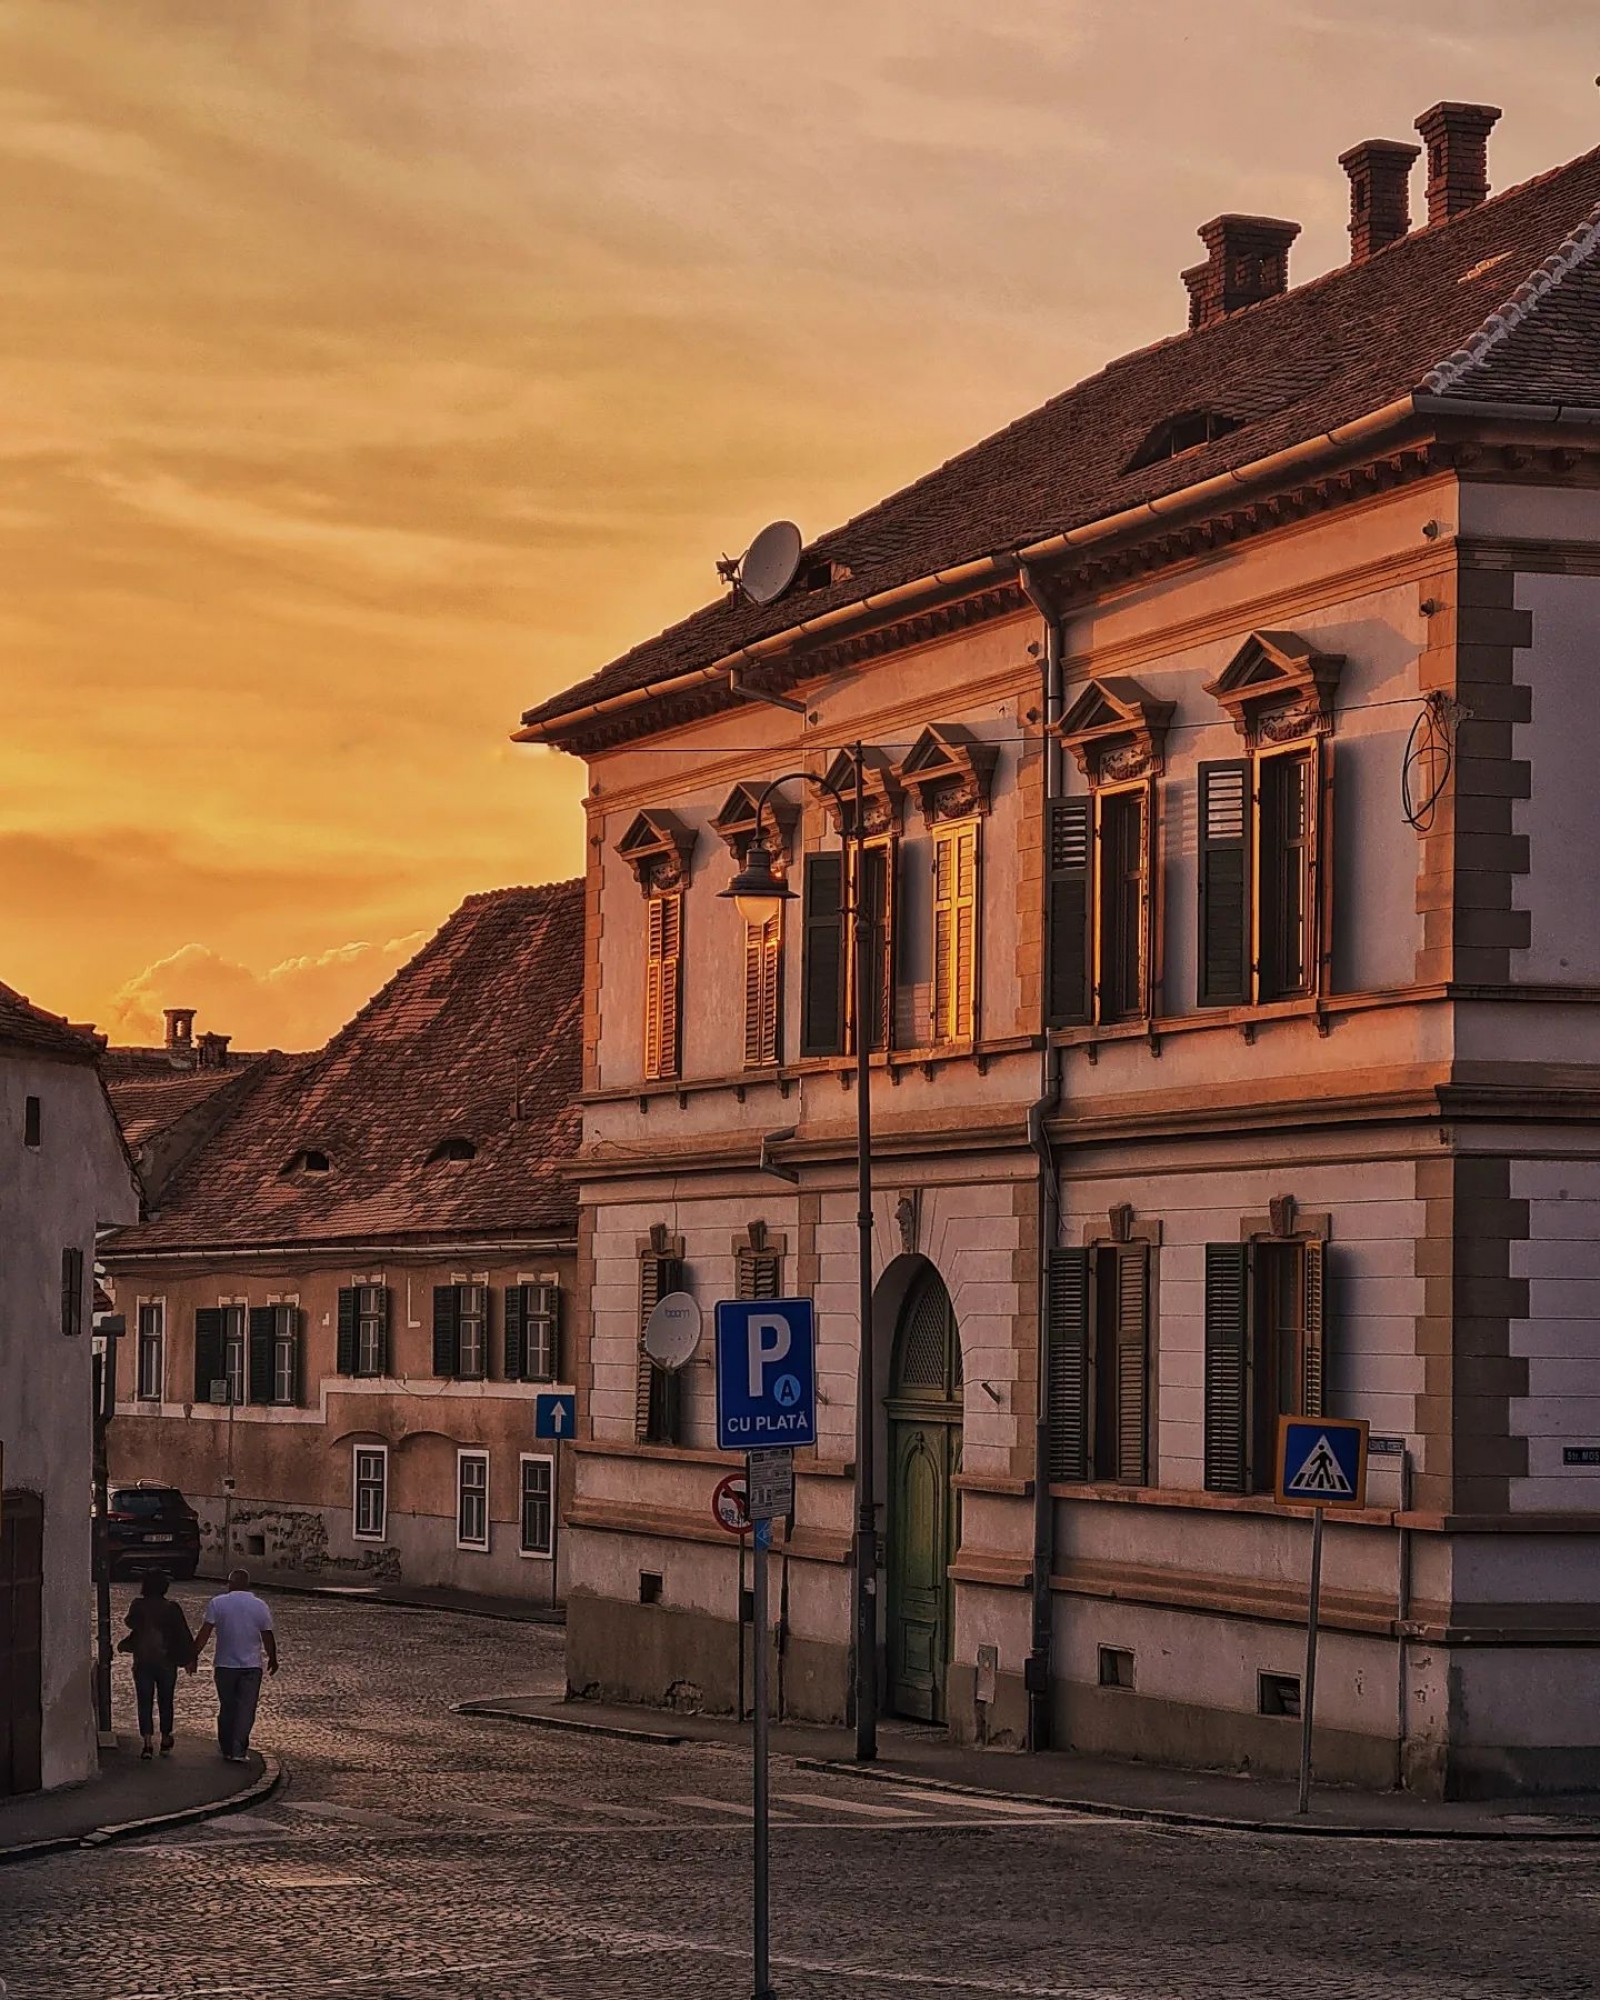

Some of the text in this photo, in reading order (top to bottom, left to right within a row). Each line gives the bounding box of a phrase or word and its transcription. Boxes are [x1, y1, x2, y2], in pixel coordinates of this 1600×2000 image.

[747, 1313, 792, 1397] P
[780, 1379, 795, 1402] A
[728, 1411, 808, 1432] CU PLATĂ
